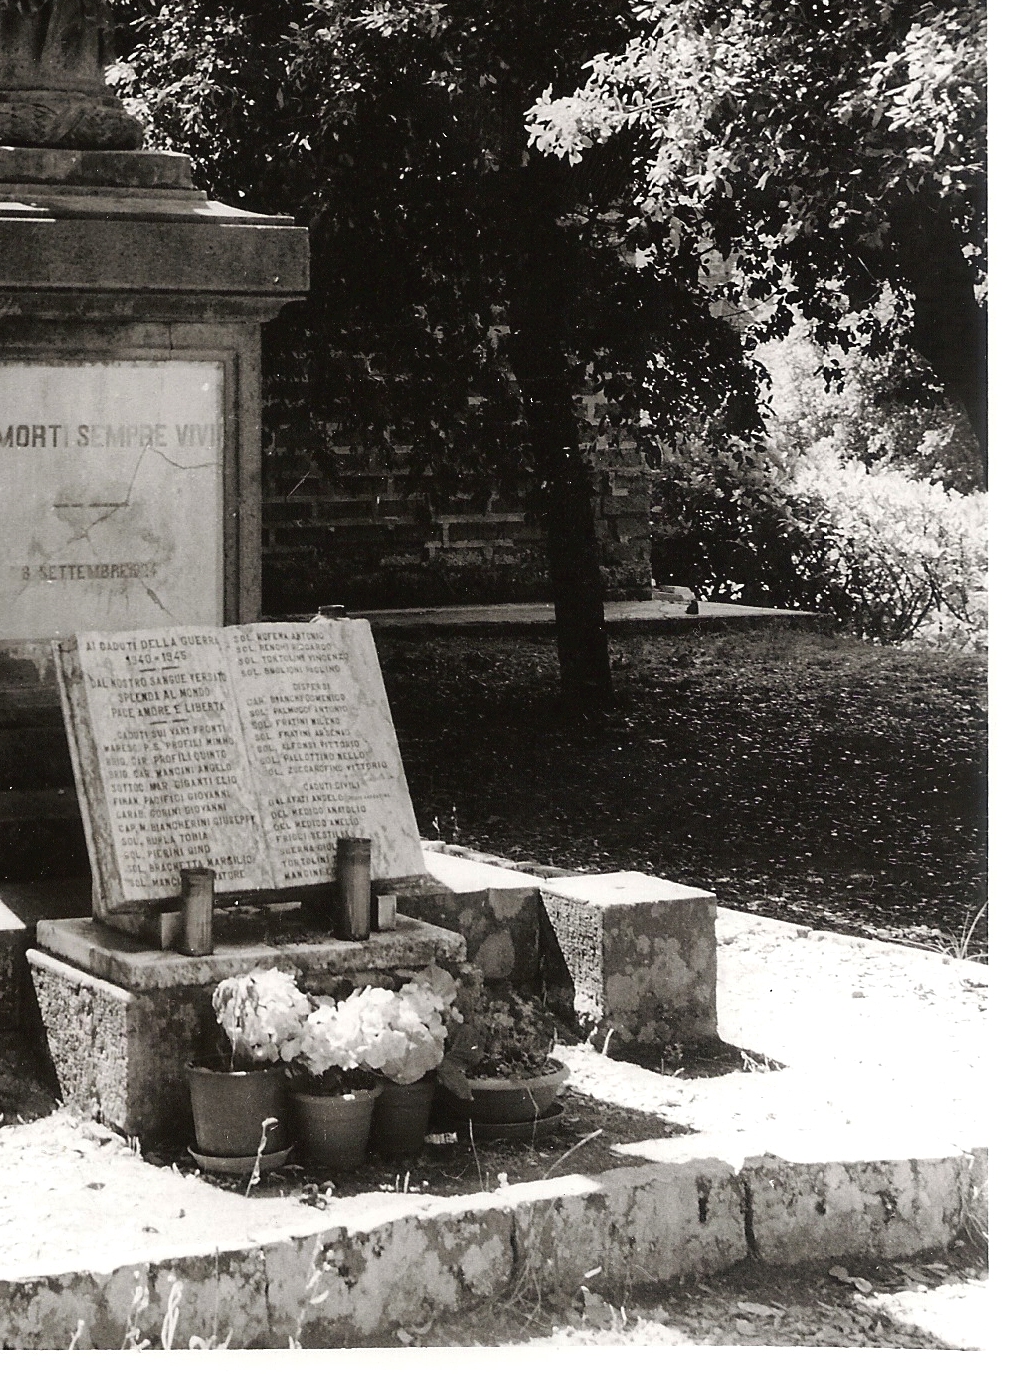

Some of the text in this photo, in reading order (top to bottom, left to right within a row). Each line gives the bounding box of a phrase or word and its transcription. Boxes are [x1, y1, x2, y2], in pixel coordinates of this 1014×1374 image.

[76, 425, 167, 447] SEMPRE
[86, 635, 219, 651] AI CADUTI DELLA GUERRA
[111, 677, 147, 688] NOSTRO
[150, 674, 187, 686] SANGUE
[163, 689, 177, 699] AL
[179, 687, 211, 697] MONDO
[111, 708, 135, 718] PACE
[138, 705, 171, 717] AMORE
[174, 704, 181, 714] E
[118, 724, 226, 740] CADUTI SUI VARI FRONTI
[166, 739, 202, 749] PROFILI
[153, 752, 192, 764] PROFILI
[194, 749, 227, 761] QUINTO
[155, 767, 195, 778] MANCINI
[198, 763, 232, 774] ANGELO
[174, 775, 237, 789] GIGANTI ELIO
[187, 790, 231, 800] GIOVANNI
[185, 803, 226, 815] GIOVANNI
[270, 810, 288, 820] DEL
[273, 823, 291, 831] DEL
[187, 844, 211, 855] GINO
[206, 854, 254, 867] MARSILIO
